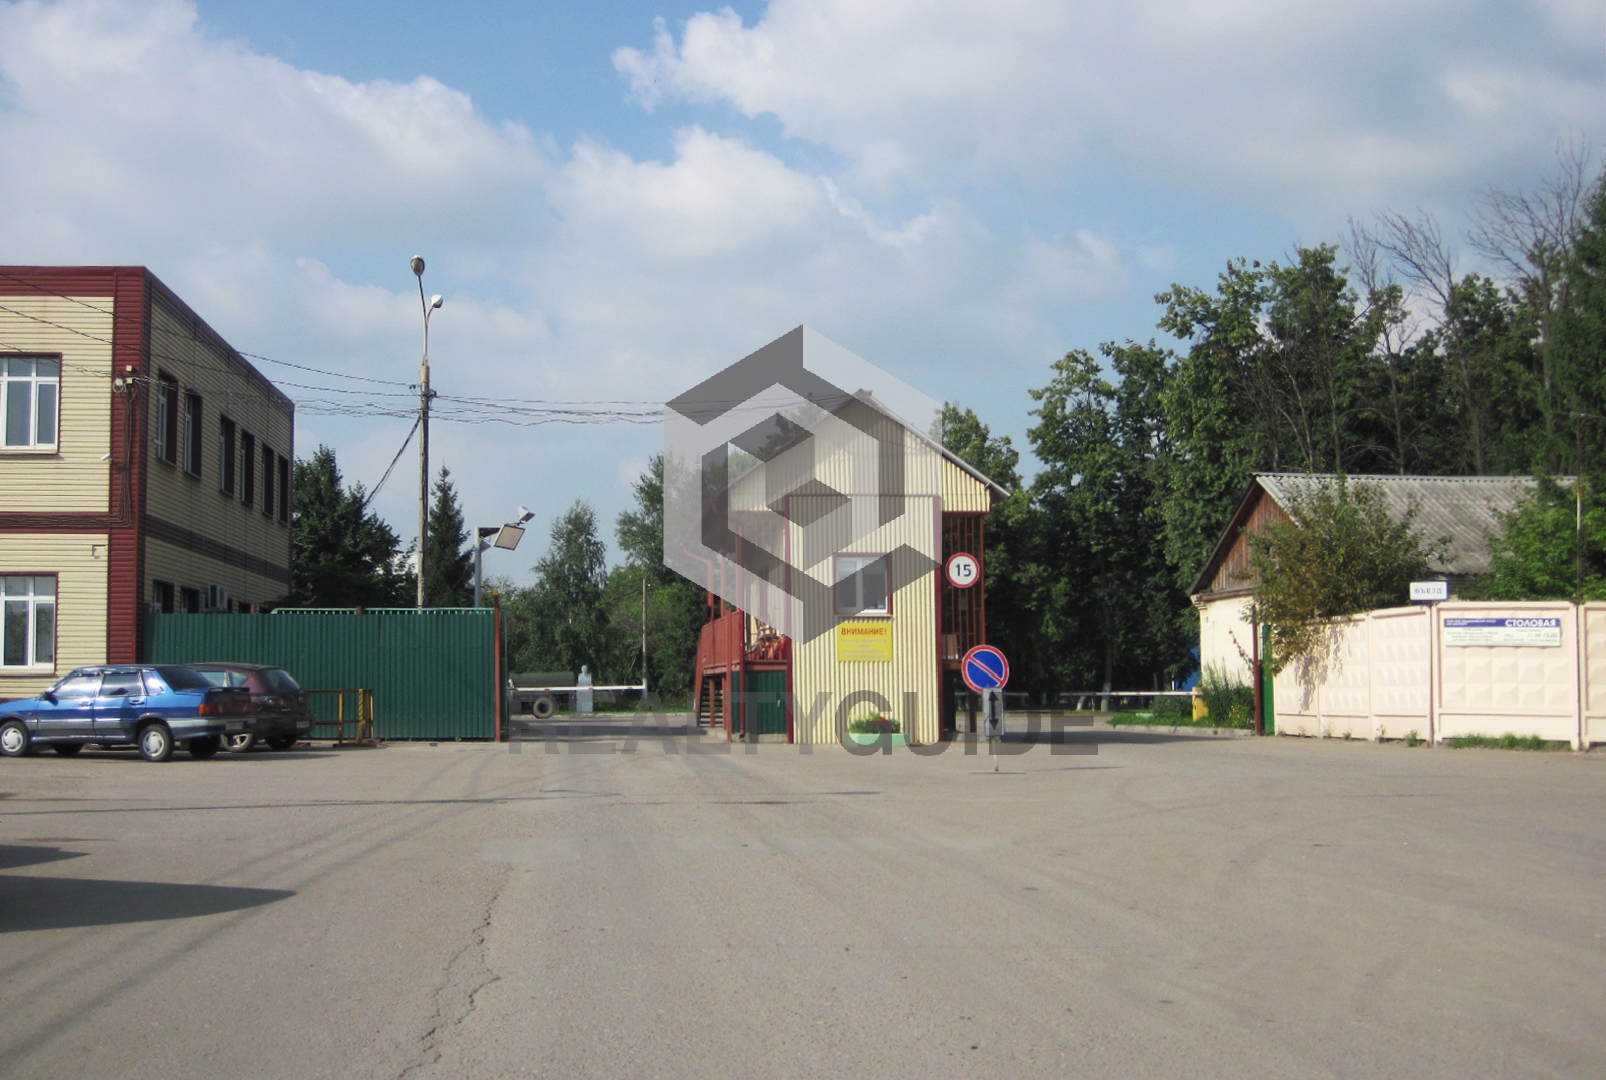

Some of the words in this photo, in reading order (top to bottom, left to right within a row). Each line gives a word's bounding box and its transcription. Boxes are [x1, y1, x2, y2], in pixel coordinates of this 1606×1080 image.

[955, 564, 972, 577] 15
[1505, 619, 1556, 627] СТОЛОВАЯ
[841, 628, 887, 636] ВНИМАНИЕ!
